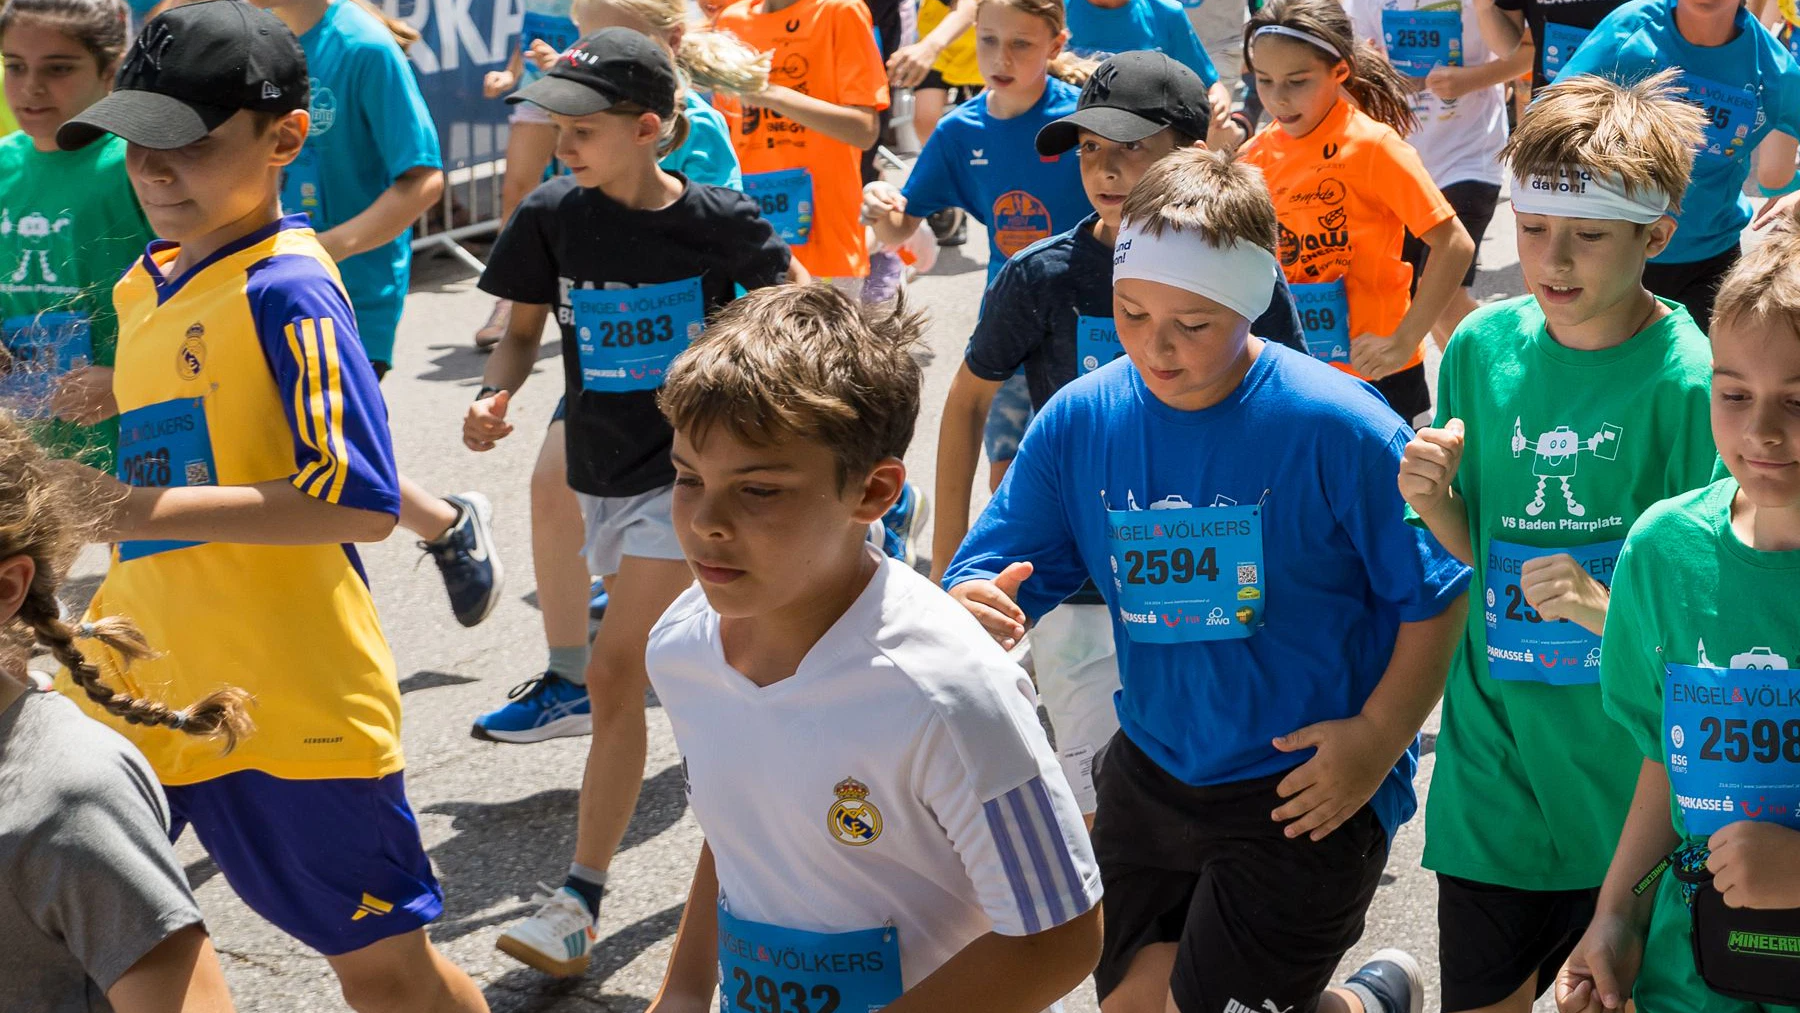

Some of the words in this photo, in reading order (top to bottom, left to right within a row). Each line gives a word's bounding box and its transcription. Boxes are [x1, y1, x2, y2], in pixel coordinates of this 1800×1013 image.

[1397, 28, 1441, 50] 2539
[1532, 177, 1586, 194] davon!
[580, 290, 697, 315] ENGEL&VÖLKERS
[601, 315, 674, 348] 2883
[1501, 515, 1516, 529] VS
[1518, 518, 1556, 531] Baden
[1559, 515, 1623, 533] Pfarrplatz
[1124, 546, 1220, 586] 2594
[1205, 617, 1230, 626] ziwa
[303, 736, 344, 745] AEROREADY
[1634, 858, 1669, 895] MINECRAFT
[732, 965, 841, 1013] 2932
